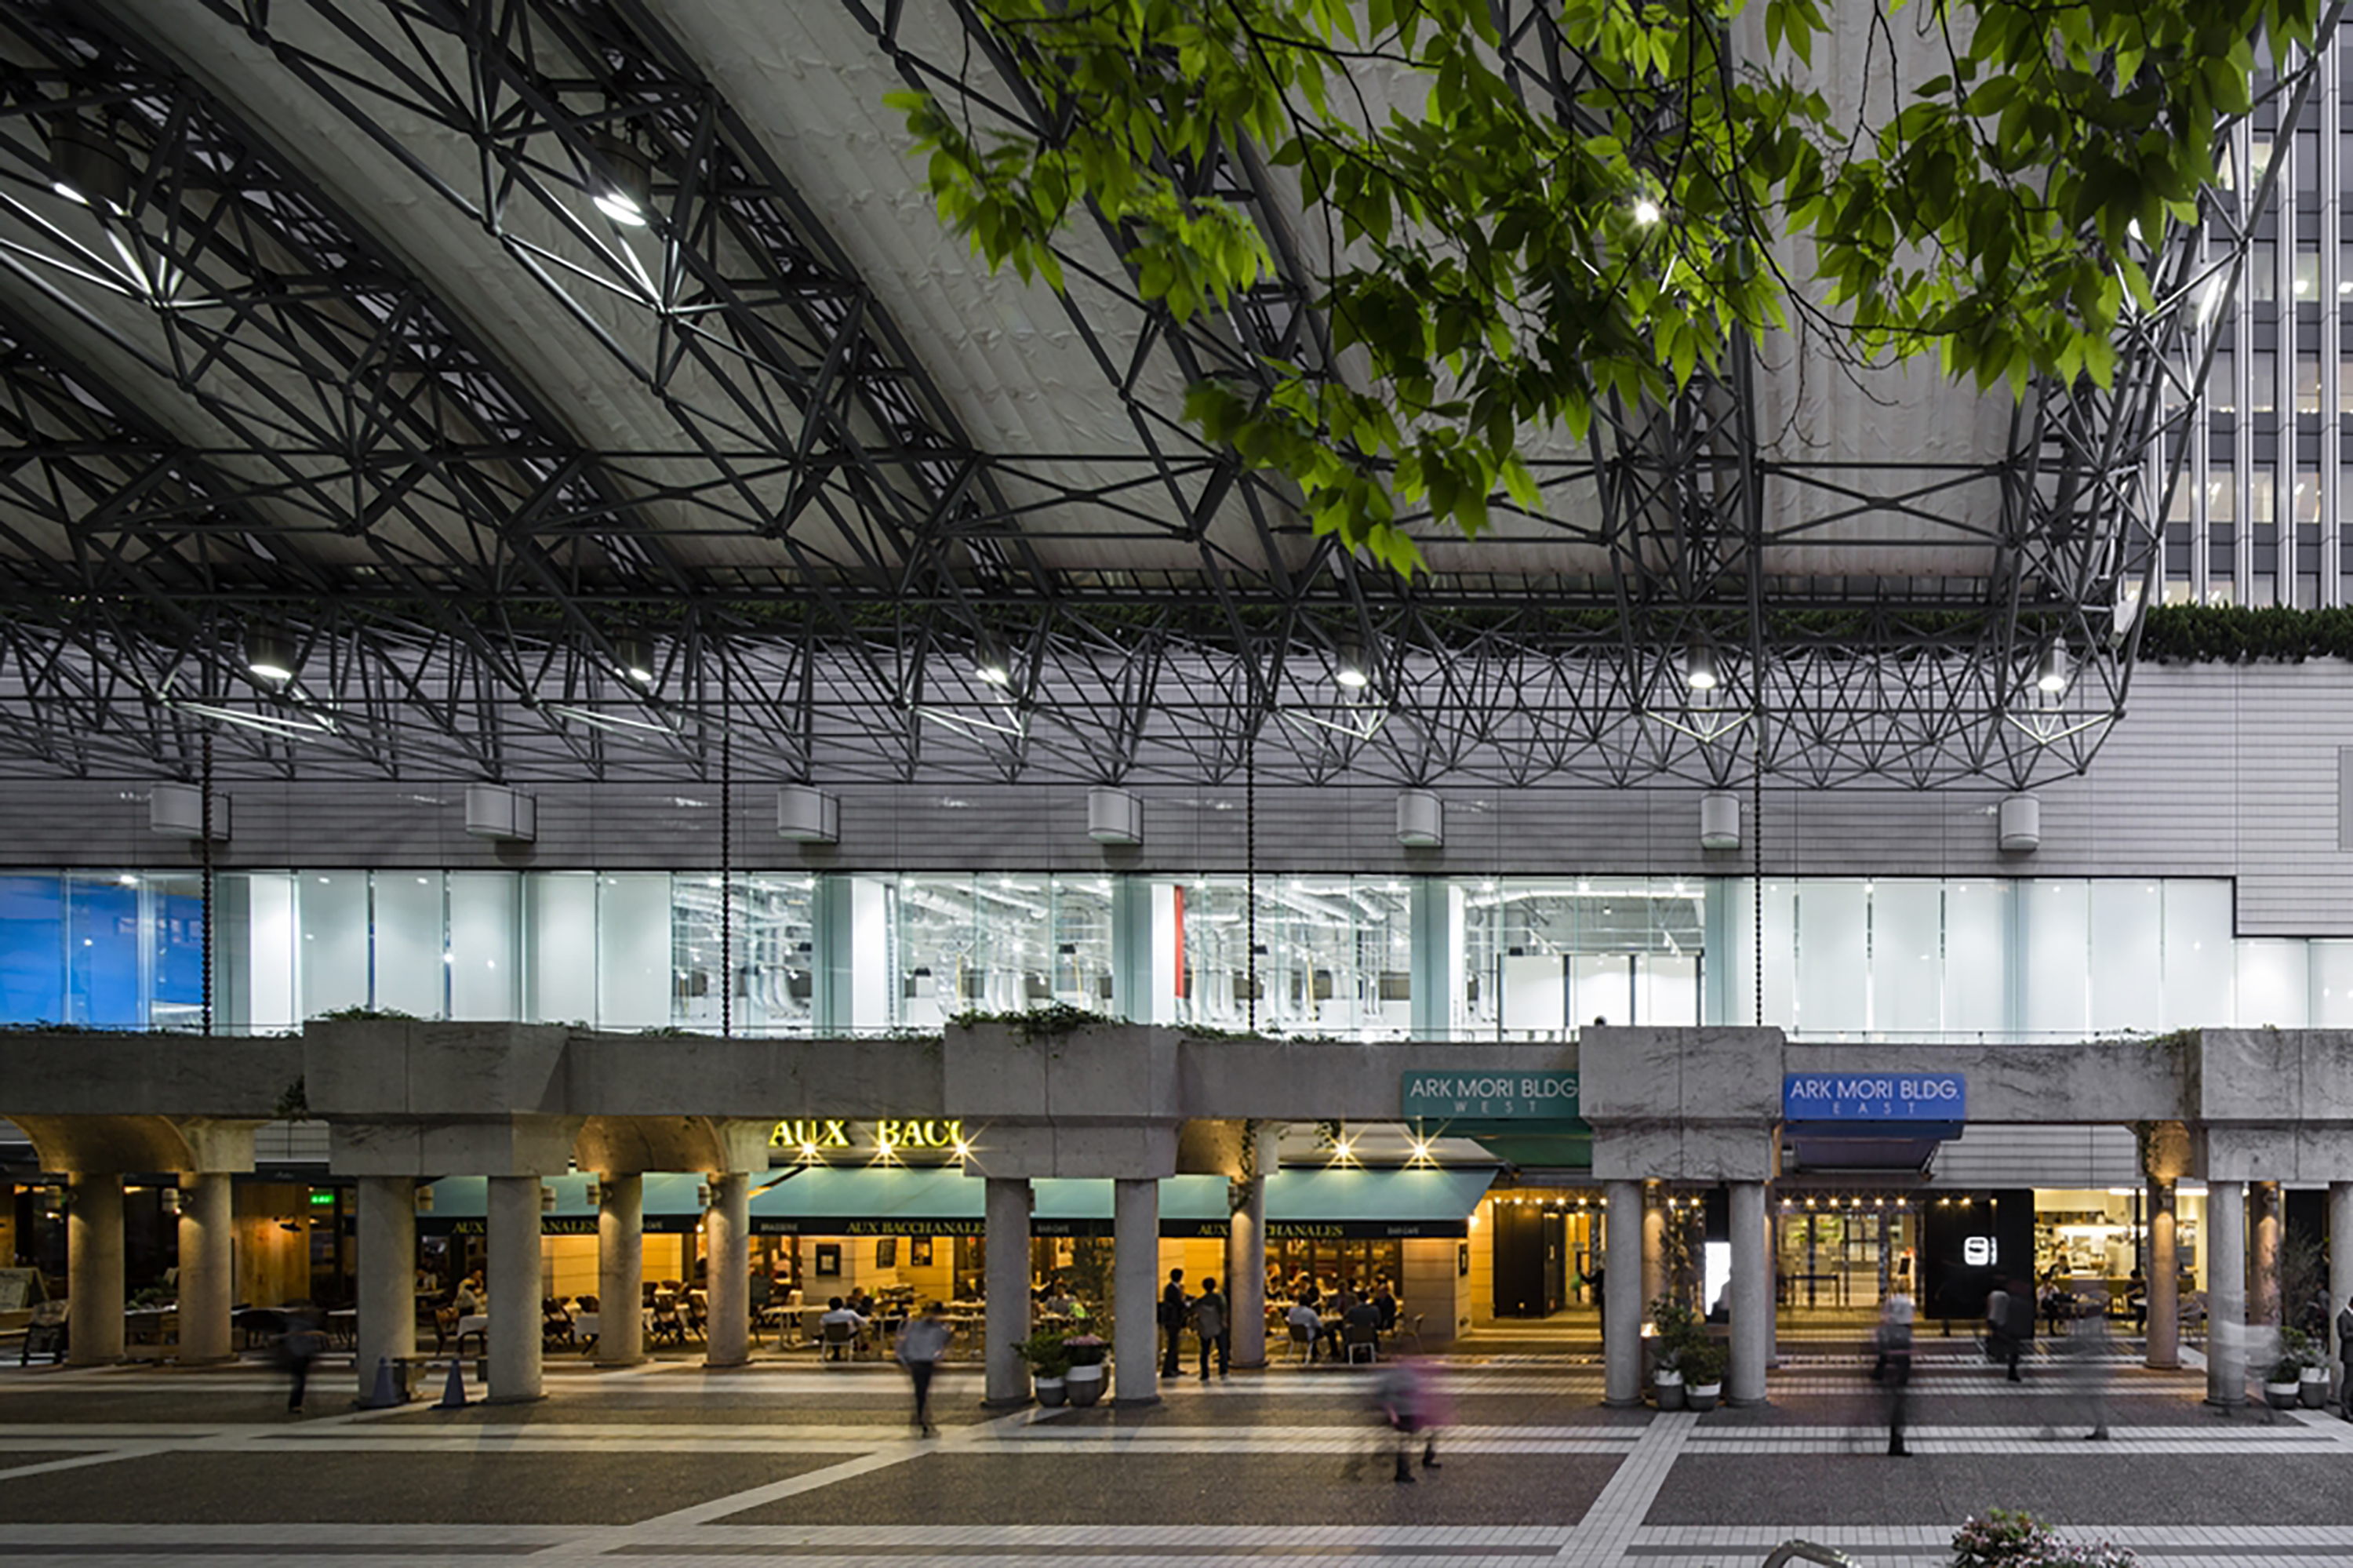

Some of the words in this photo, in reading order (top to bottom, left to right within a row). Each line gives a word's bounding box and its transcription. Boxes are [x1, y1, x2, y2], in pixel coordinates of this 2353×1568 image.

[1410, 1079, 1451, 1097] ARK
[1457, 1079, 1514, 1097] MORI
[1790, 1080, 1831, 1098] ARK
[1837, 1080, 1893, 1099] MORI
[1900, 1080, 1959, 1099] BLDG.
[1453, 1101, 1537, 1113] WEST
[1833, 1102, 1915, 1115] EAST
[769, 1120, 849, 1147] AUX
[452, 1222, 485, 1234] AUX
[541, 1221, 599, 1233] ANALES
[846, 1222, 878, 1234] AUX
[882, 1222, 985, 1234] BACCHANALE
[1198, 1224, 1229, 1235] AUX
[1265, 1224, 1344, 1235] CHANALES
